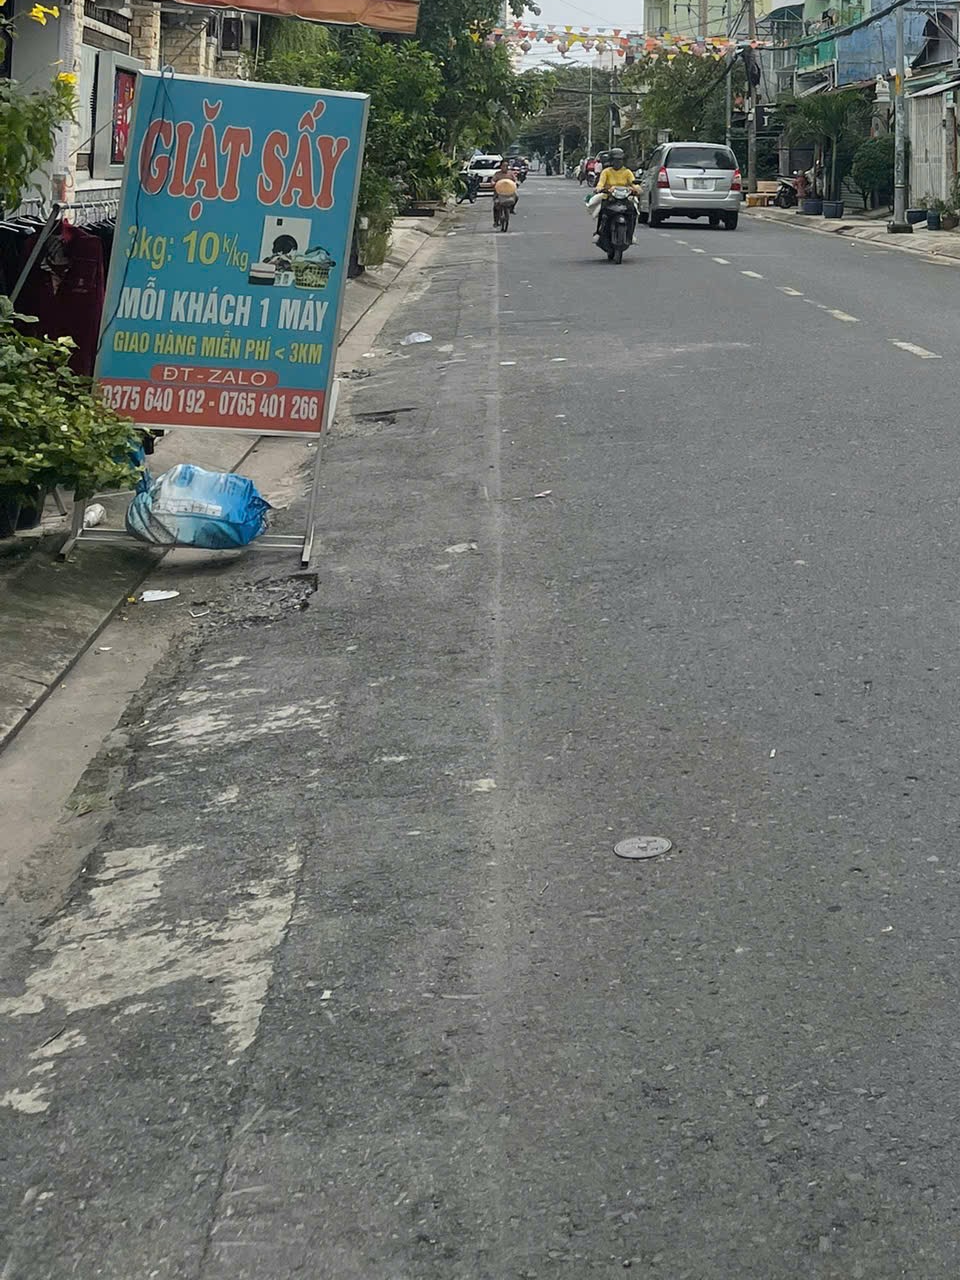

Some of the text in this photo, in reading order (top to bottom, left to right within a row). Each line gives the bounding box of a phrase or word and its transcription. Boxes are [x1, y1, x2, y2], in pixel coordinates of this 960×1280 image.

[139, 99, 252, 221] GIẶT
[257, 100, 350, 209] SẤY
[126, 225, 174, 269] 3kg:
[117, 276, 329, 332] MỖI KHÁCH 1 MÁY
[113, 331, 149, 353] GIAO
[154, 329, 197, 356] HÀNG
[201, 330, 241, 359] MIỄN
[244, 336, 271, 361] PHÍ
[288, 342, 323, 365] 3KM
[101, 384, 142, 411] 0375
[144, 387, 173, 412] 640
[178, 389, 205, 414] 192
[219, 391, 256, 417] 0765
[259, 394, 286, 418] 401
[290, 396, 318, 420] 266
